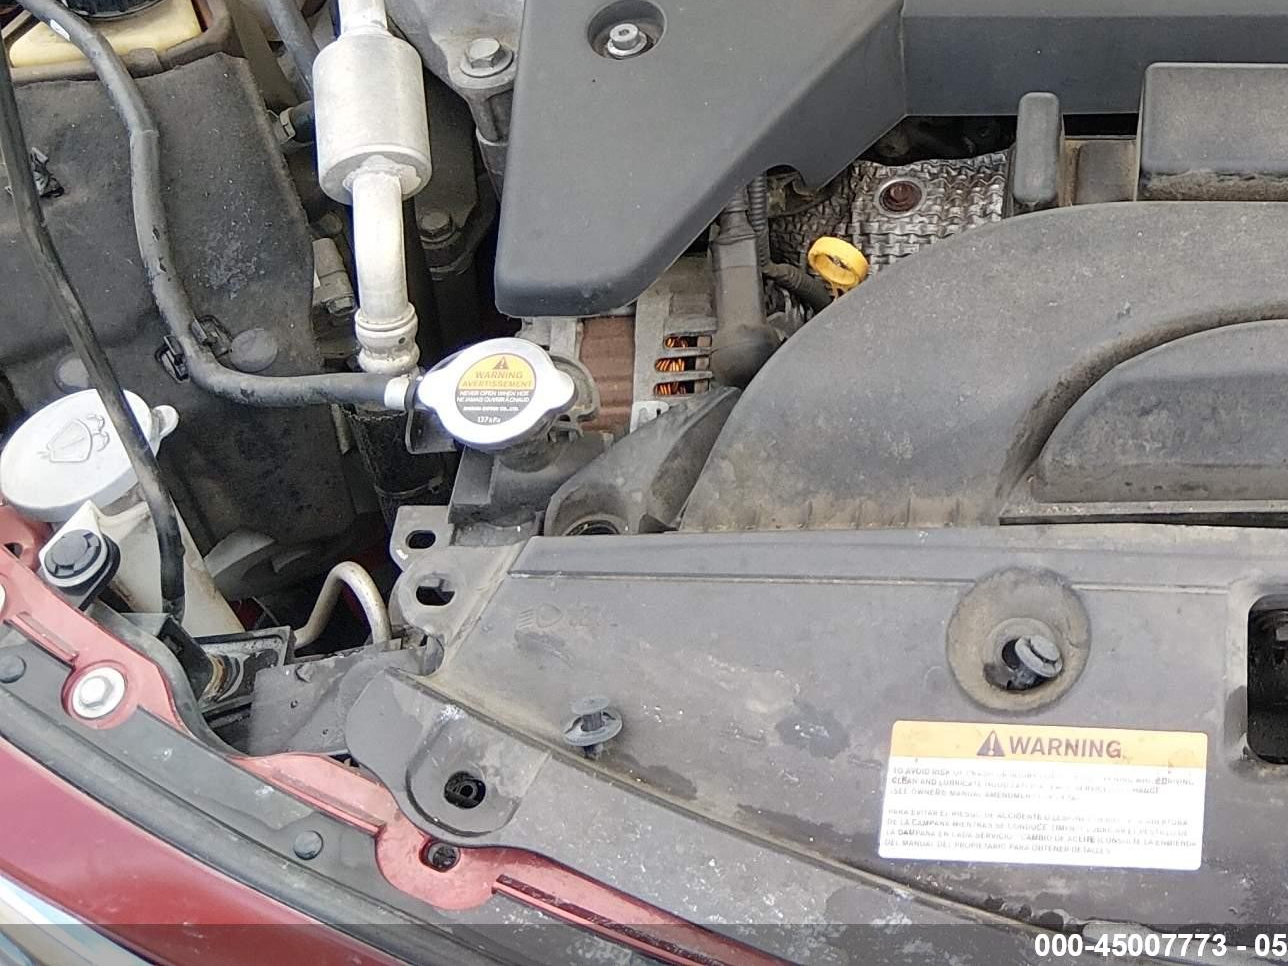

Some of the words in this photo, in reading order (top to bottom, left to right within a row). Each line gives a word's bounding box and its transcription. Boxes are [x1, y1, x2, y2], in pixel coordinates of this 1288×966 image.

[475, 370, 524, 379] WARNING
[462, 380, 532, 388] AVERTISSEMENT
[1009, 735, 1122, 759] WARNING
[905, 767, 930, 775] AVOID
[891, 776, 918, 785] CLEAN
[920, 778, 937, 786] AND
